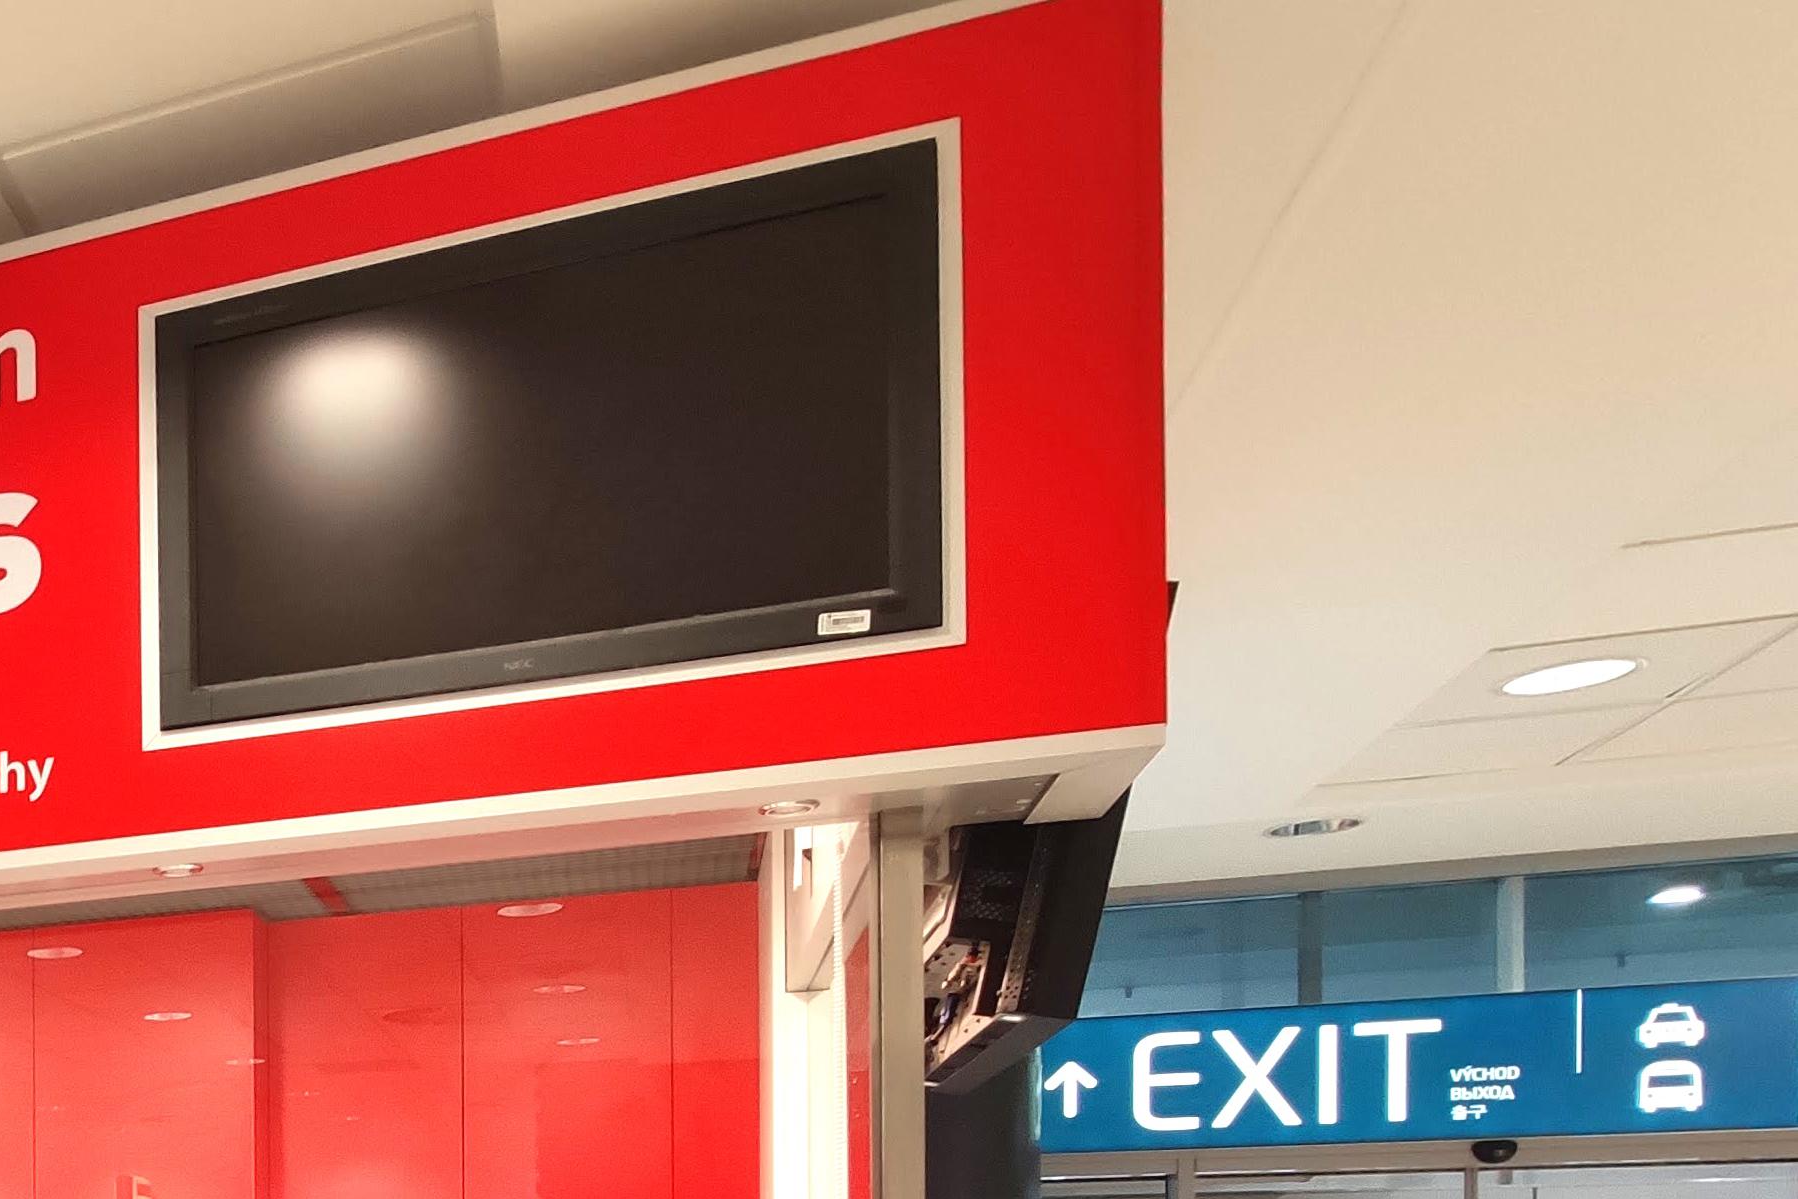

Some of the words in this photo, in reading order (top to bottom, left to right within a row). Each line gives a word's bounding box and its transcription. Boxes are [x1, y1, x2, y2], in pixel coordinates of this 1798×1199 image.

[1132, 1018, 1443, 1132] EXIT
[1450, 1065, 1521, 1083] VÝCHOD
[1450, 1085, 1516, 1101] ВЫХОД
